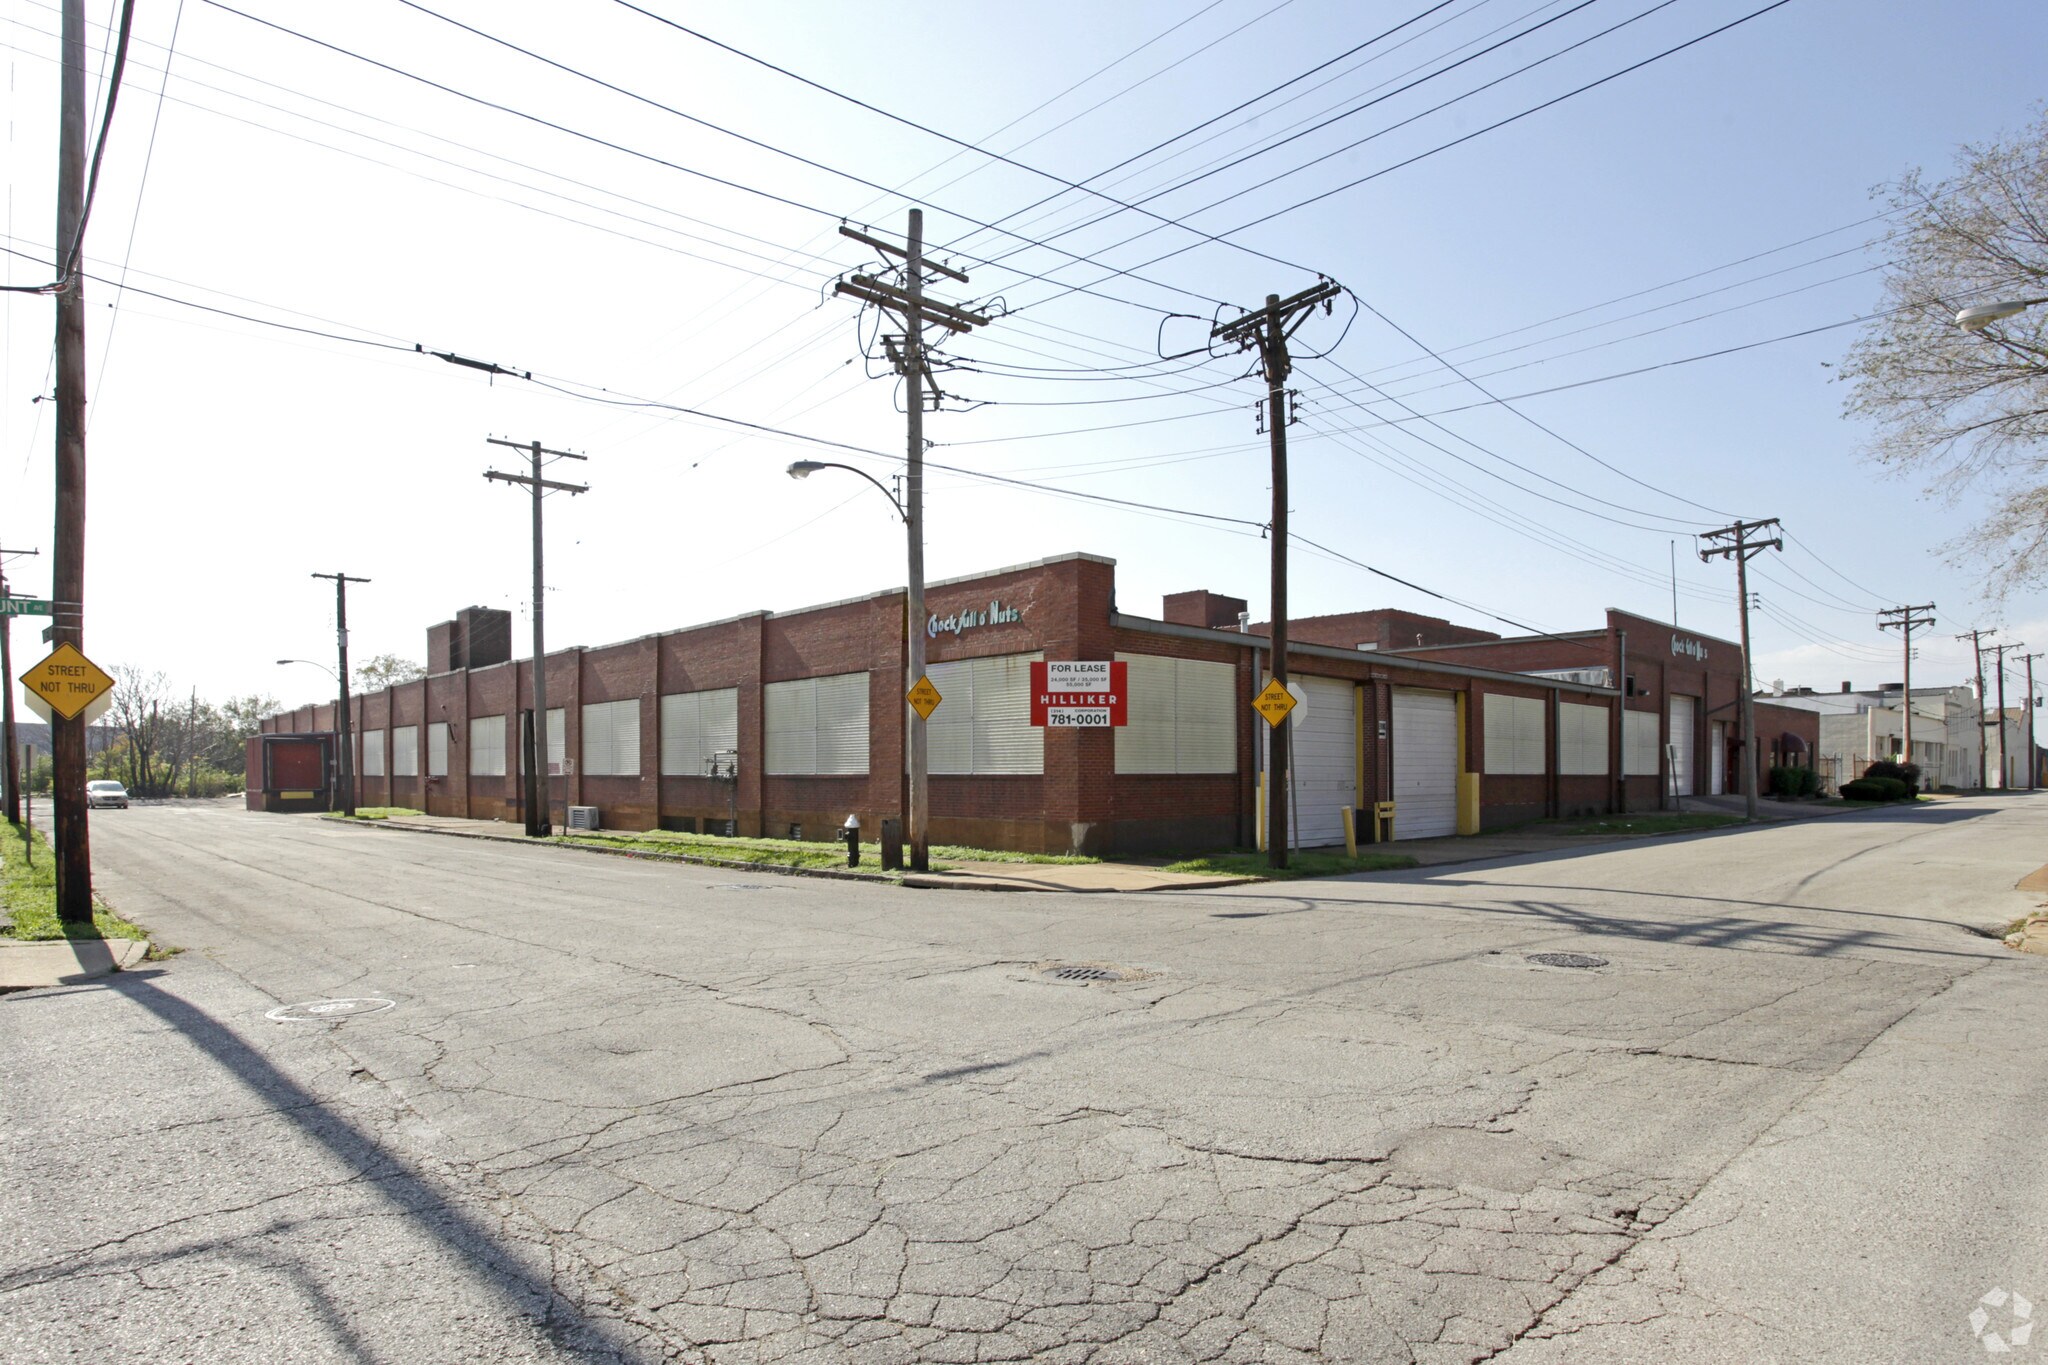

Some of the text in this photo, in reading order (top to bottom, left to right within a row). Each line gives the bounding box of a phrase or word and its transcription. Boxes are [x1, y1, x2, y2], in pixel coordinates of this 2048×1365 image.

[927, 614, 957, 638] Chock
[48, 665, 86, 676] STREET
[40, 682, 95, 693] NOT THRU
[1040, 695, 1117, 704] HILLIKER
[1051, 714, 1107, 724] 781-0001
